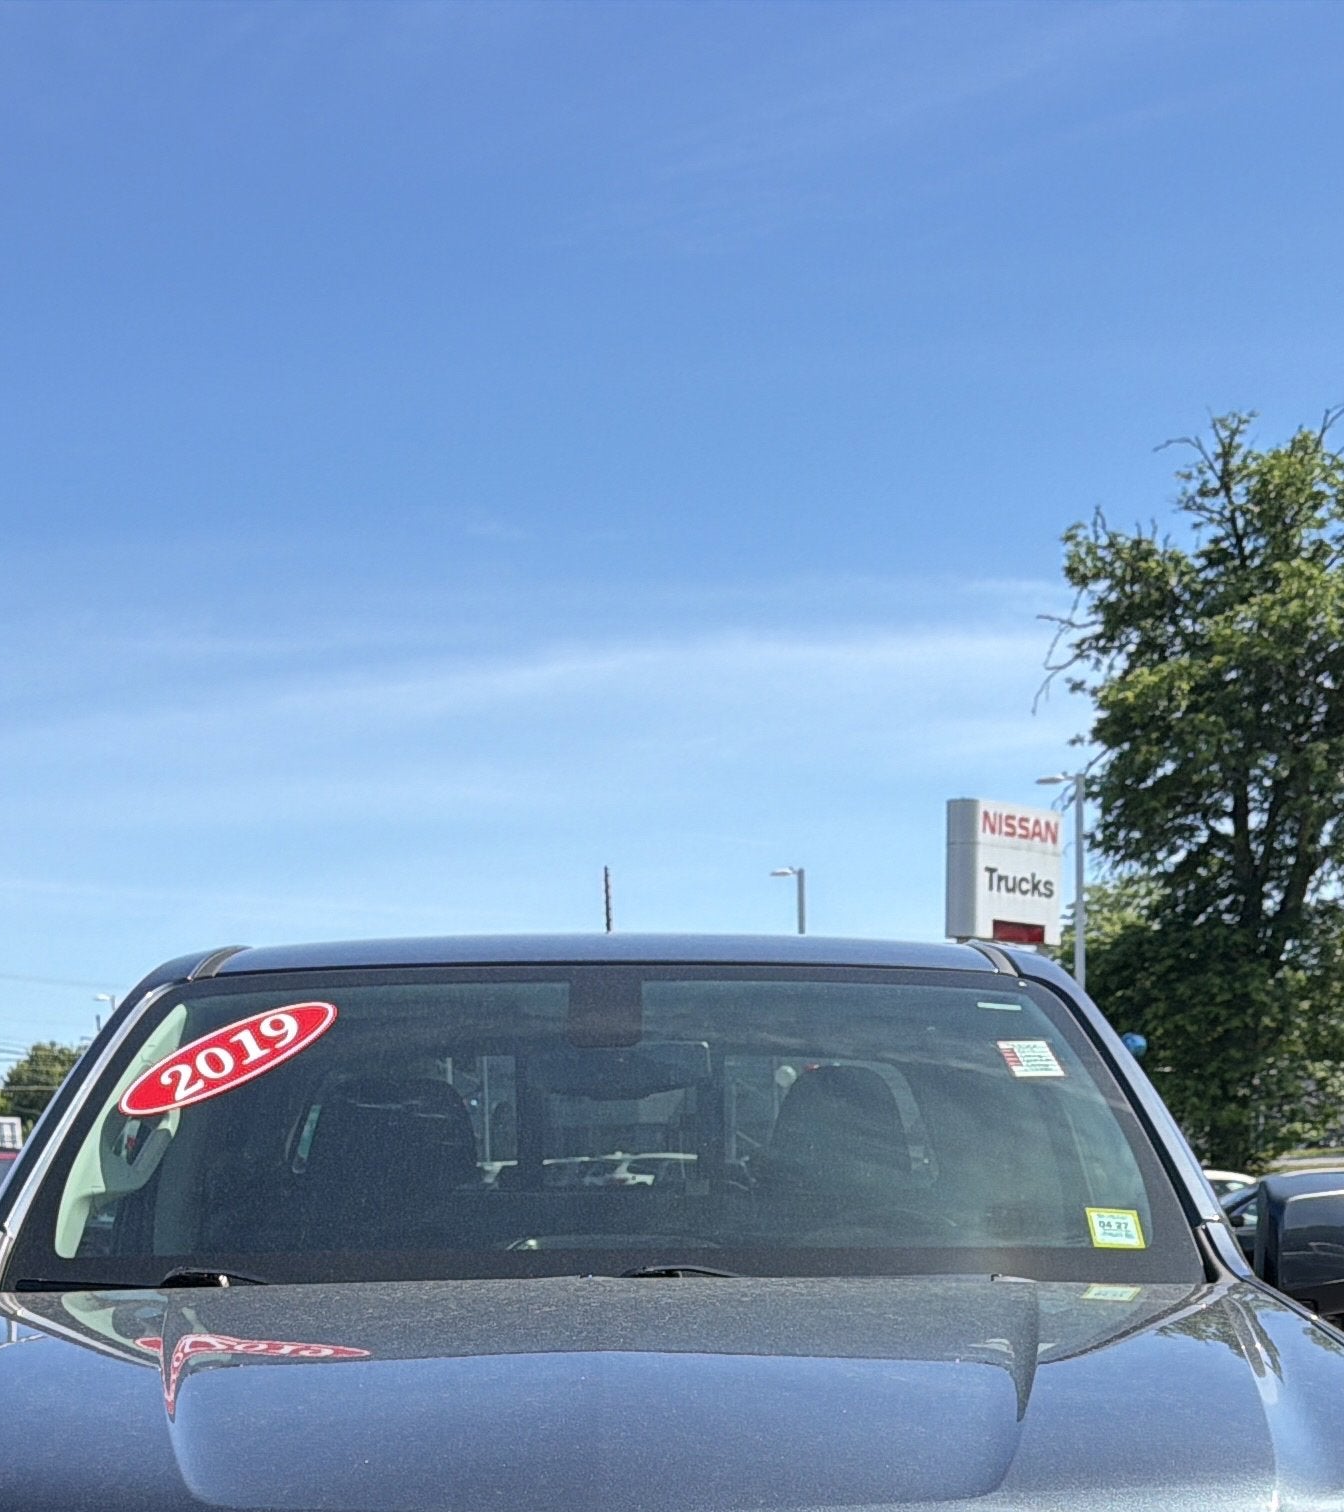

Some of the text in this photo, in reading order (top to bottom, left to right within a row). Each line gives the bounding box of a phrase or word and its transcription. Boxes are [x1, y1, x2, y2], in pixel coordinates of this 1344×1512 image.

[982, 810, 1059, 845] NISSAN
[984, 866, 1054, 898] Trucks
[160, 1013, 299, 1101] 2019
